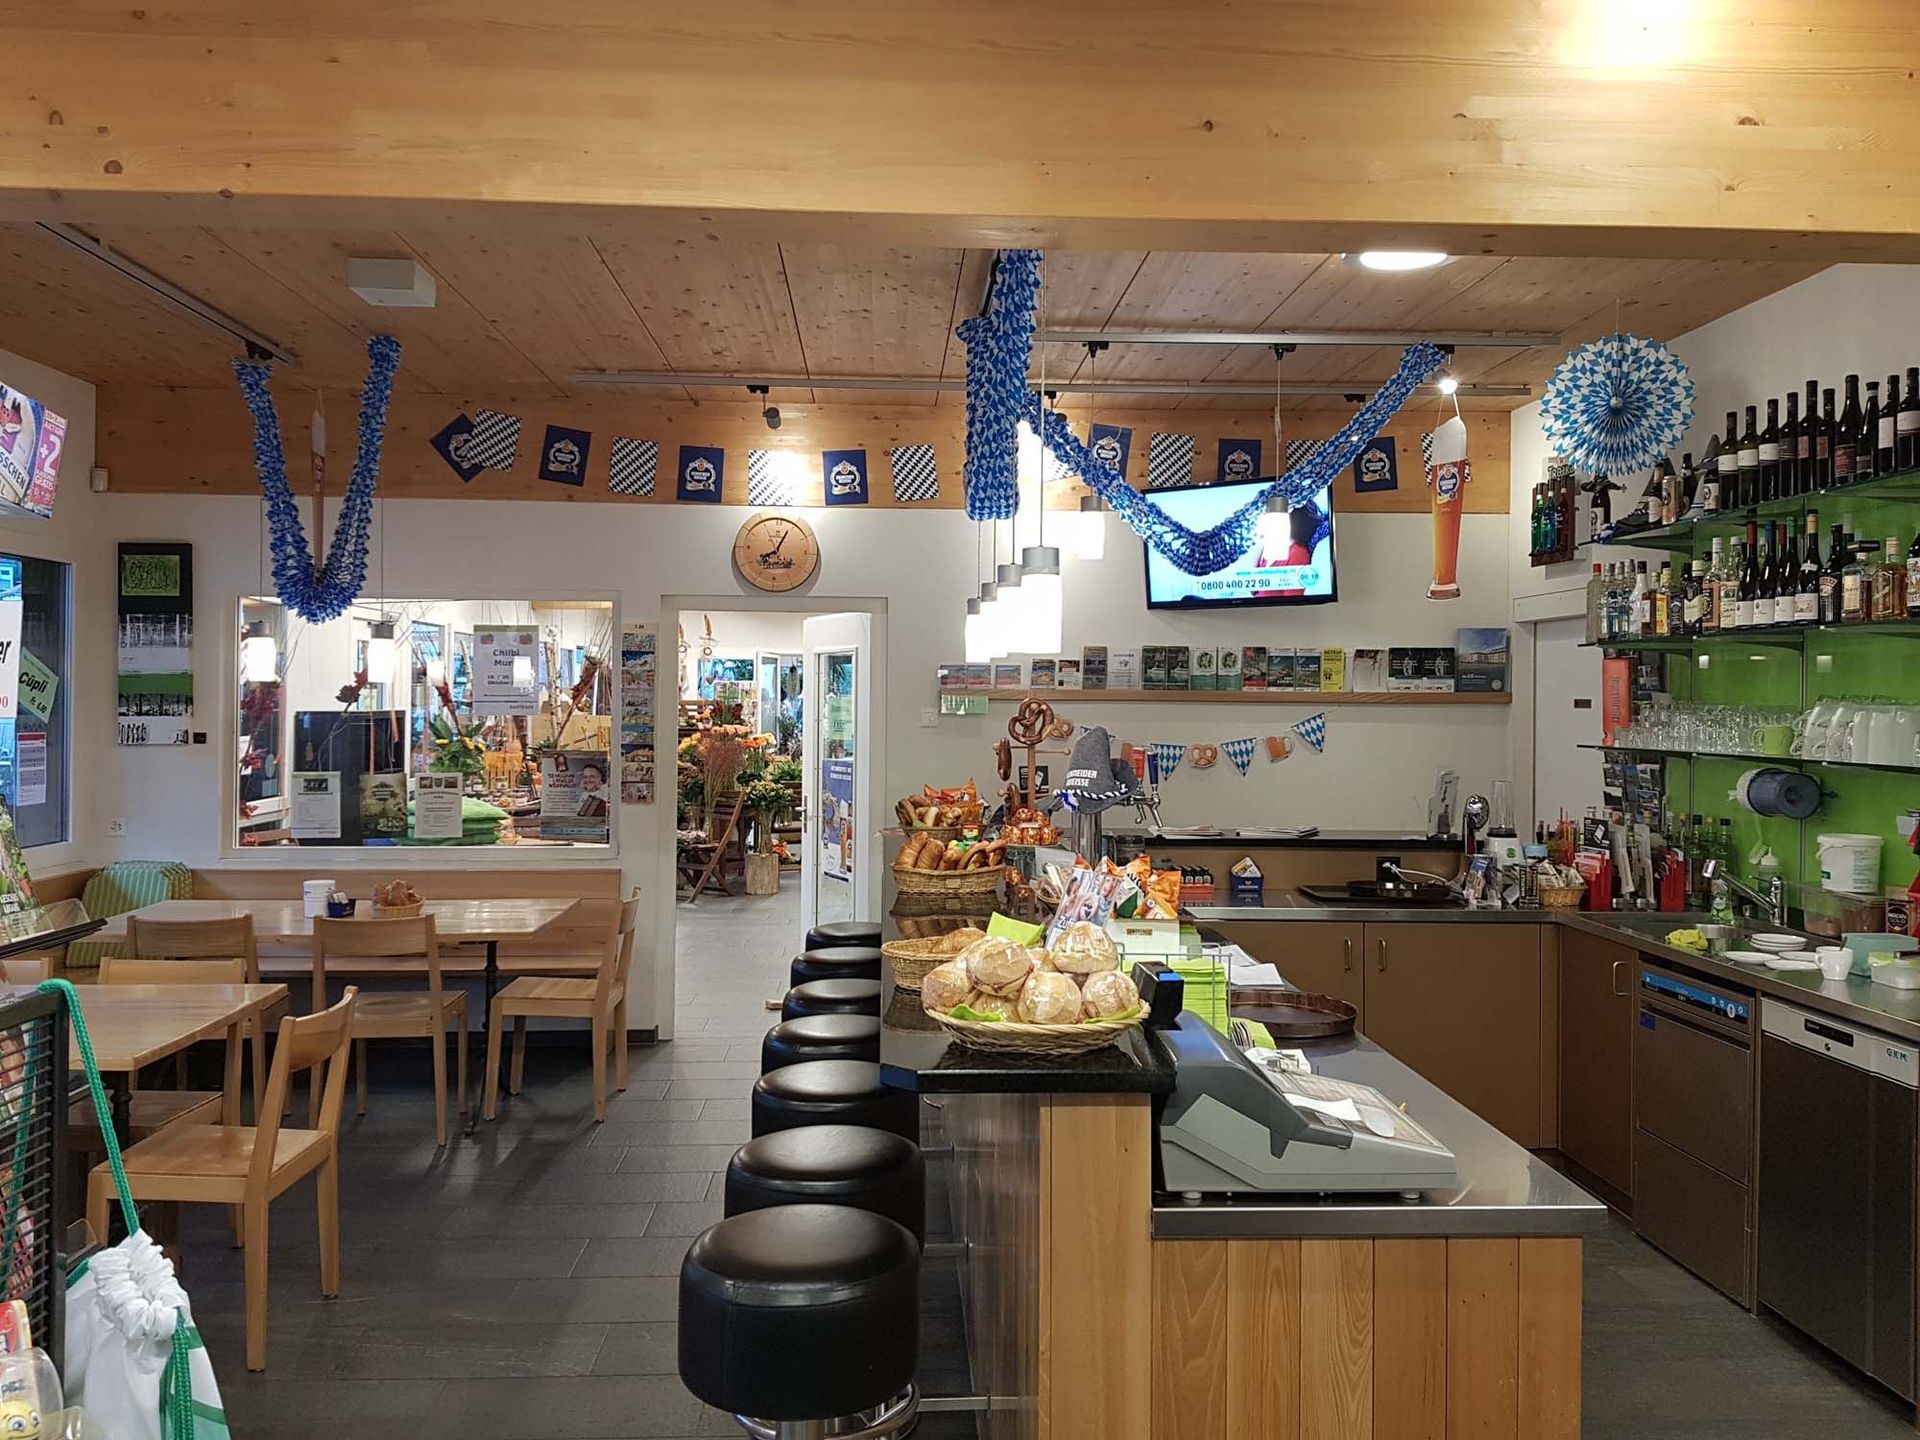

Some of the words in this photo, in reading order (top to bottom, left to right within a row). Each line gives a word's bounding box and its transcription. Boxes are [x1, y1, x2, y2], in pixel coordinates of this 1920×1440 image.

[1201, 581, 1224, 591] 0800
[1226, 580, 1243, 589] 400
[1245, 579, 1256, 589] 22
[1258, 578, 1271, 588] 90
[492, 648, 520, 657] Chilbi
[18, 671, 49, 694] Cüpli
[1886, 1047, 1908, 1062] GKM
